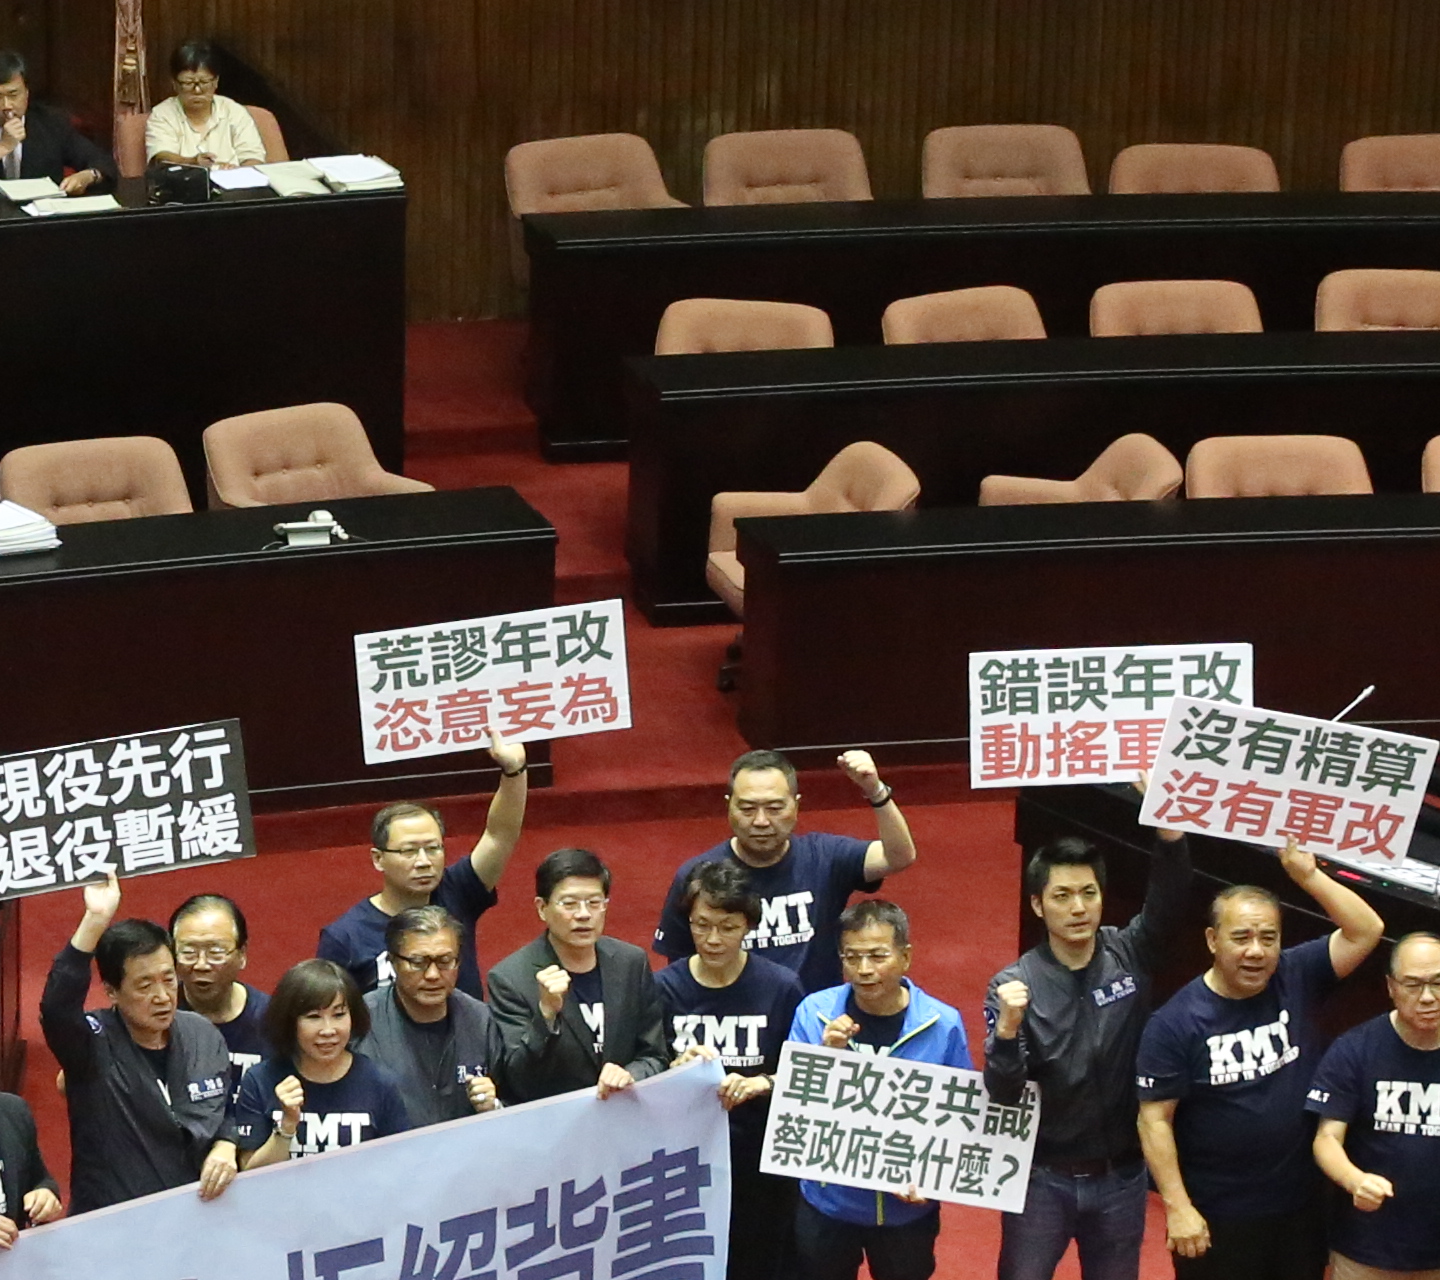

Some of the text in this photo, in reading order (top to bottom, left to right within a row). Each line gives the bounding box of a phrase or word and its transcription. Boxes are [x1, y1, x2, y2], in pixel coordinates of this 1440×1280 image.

[369, 609, 614, 694] 荒謬年改
[978, 651, 1246, 716] 錯誤年改
[374, 672, 619, 753] 恣意妄為
[979, 717, 1167, 781] 動搖軍
[1170, 705, 1428, 798] 沒有精算
[1152, 768, 1406, 863] 沒有軍改
[672, 1014, 769, 1057] KMT
[1206, 1010, 1291, 1076] KMT
[782, 1050, 1035, 1142] 軍改沒共識
[770, 1113, 1022, 1200] 蔡政府急什麼?
